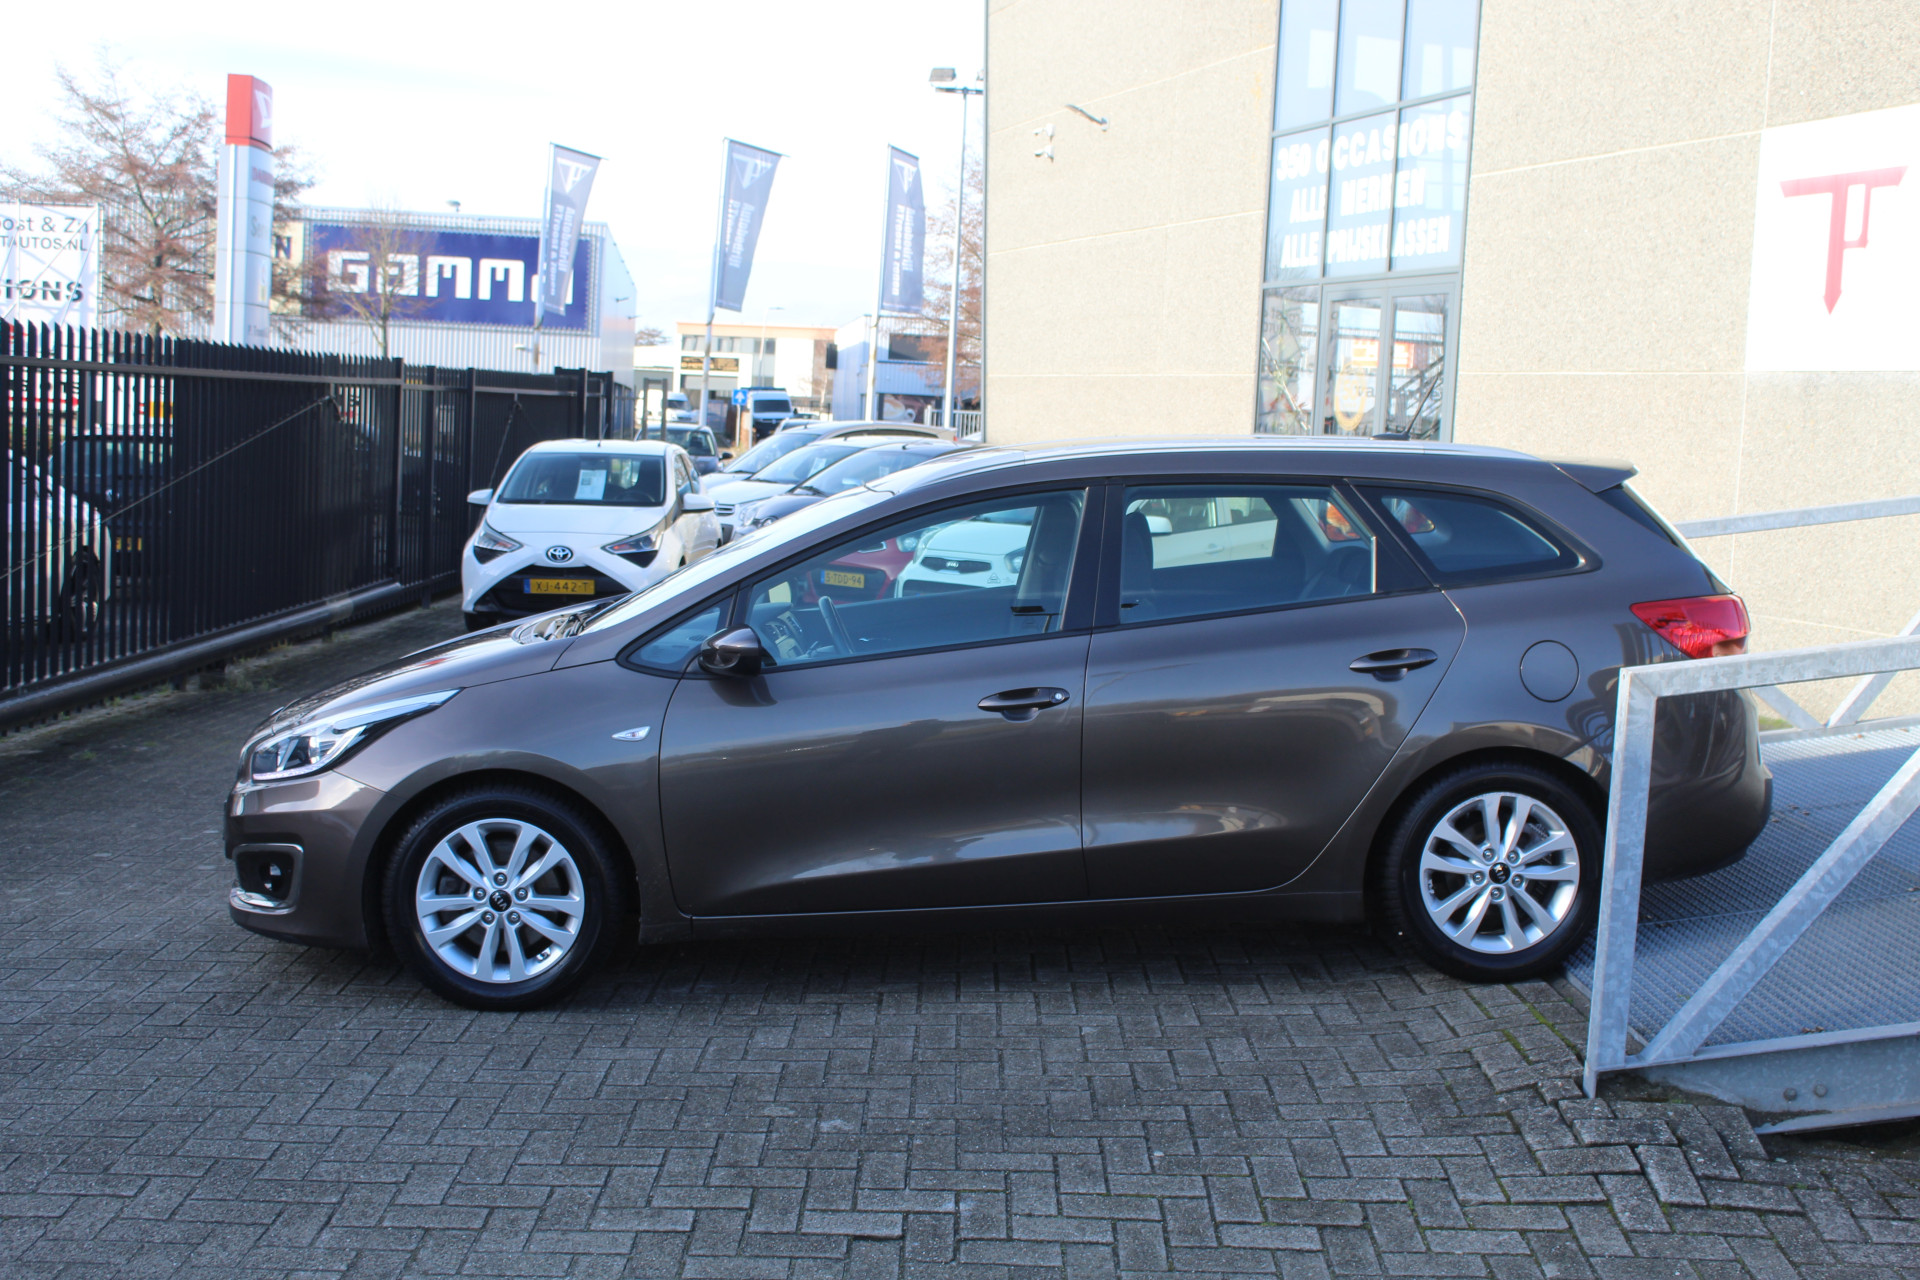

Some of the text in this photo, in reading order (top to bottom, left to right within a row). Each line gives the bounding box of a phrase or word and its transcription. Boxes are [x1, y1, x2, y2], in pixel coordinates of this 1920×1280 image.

[1276, 110, 1464, 182] 350 OCCASIONS
[0, 216, 35, 232] ost
[41, 216, 56, 233] &
[1280, 231, 1320, 269] ALLE
[0, 278, 84, 303] IONS
[535, 581, 589, 593] XJ-442-T
